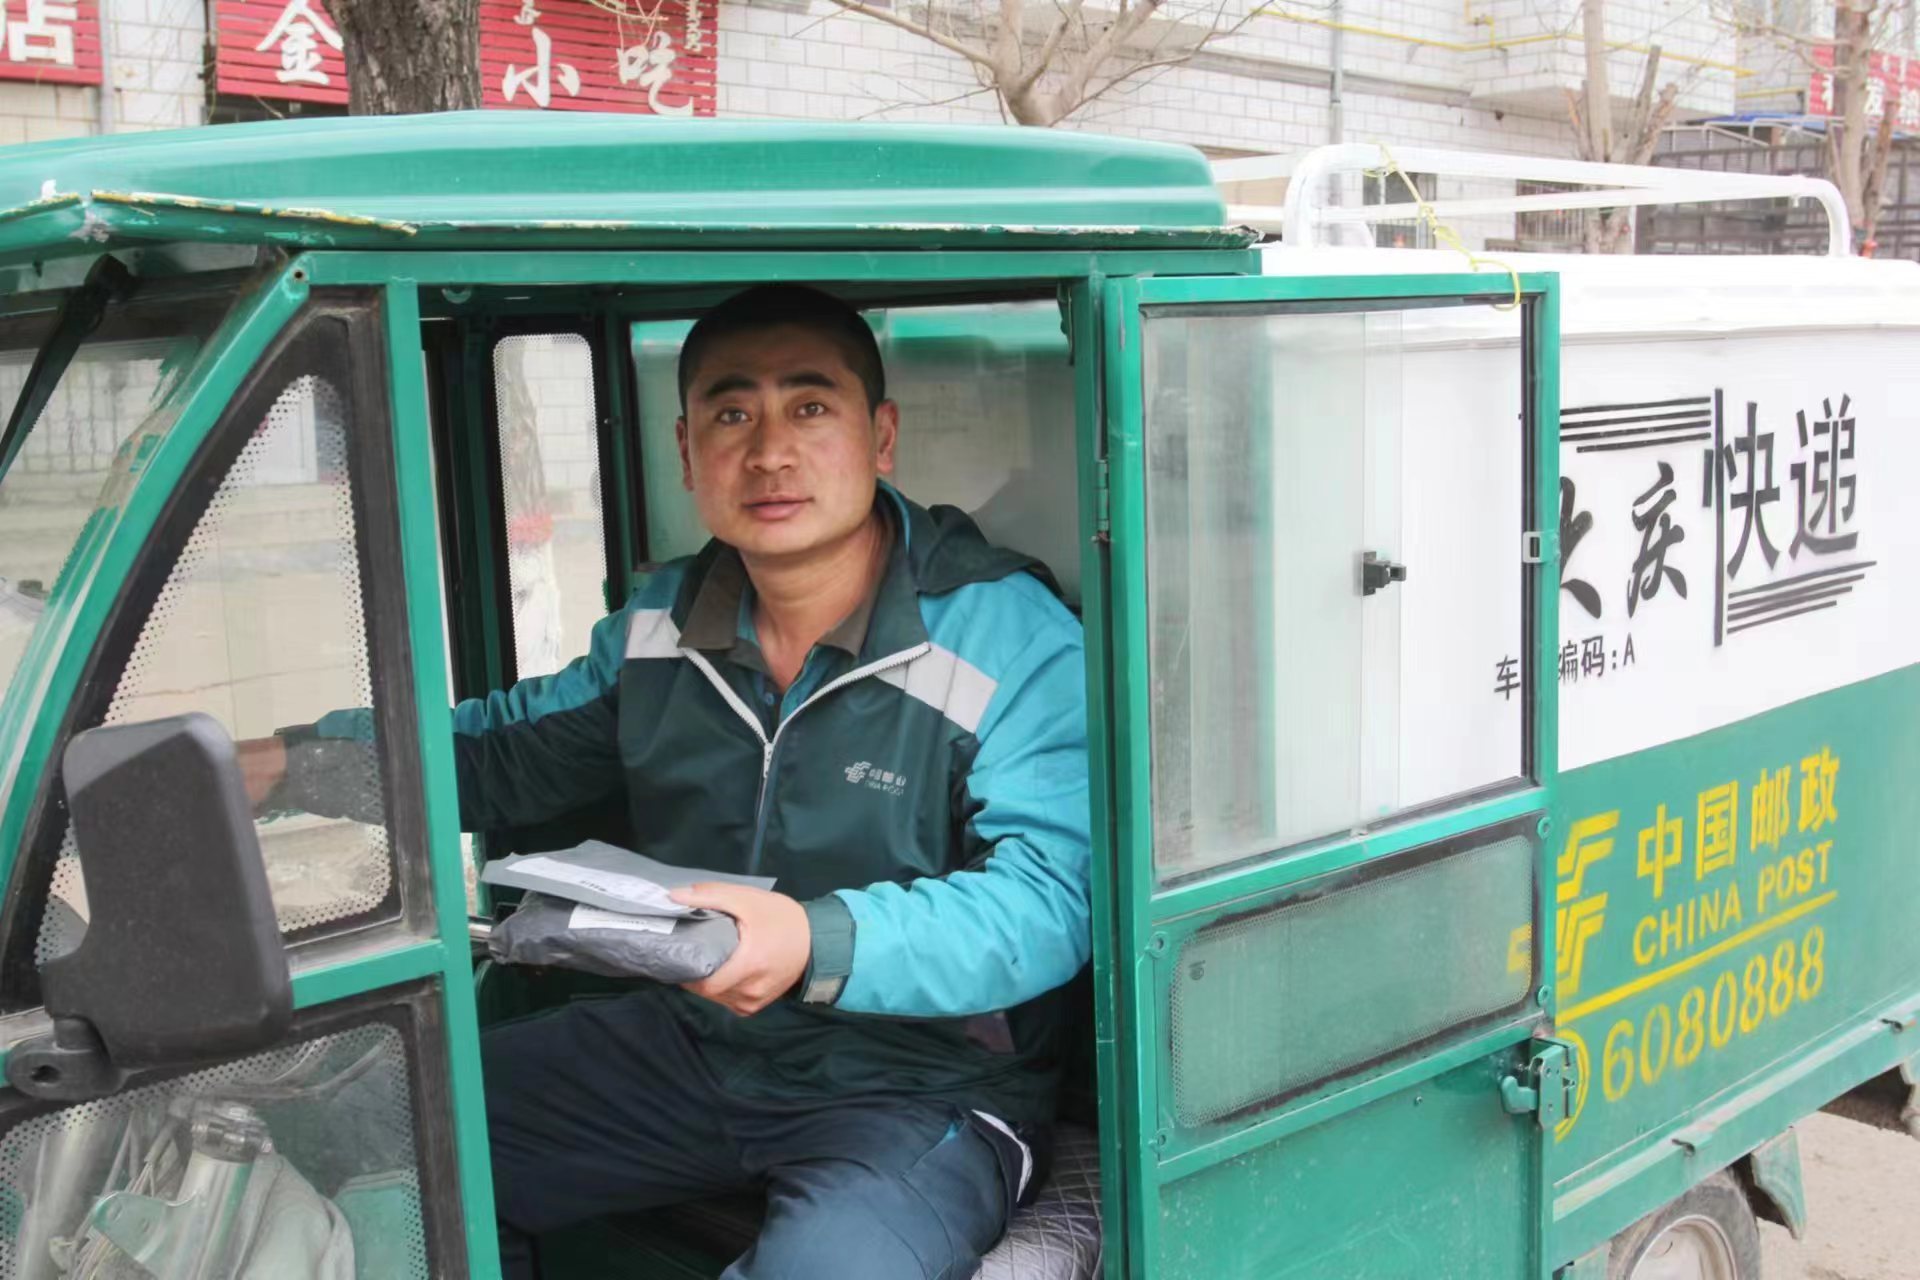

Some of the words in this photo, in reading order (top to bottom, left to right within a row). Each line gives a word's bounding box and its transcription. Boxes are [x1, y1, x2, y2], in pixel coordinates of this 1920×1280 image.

[255, 0, 344, 86] 金
[502, 27, 693, 116] 小吃
[1494, 632, 1635, 700] 车编码:A
[1636, 746, 1840, 899] 中国邮政
[1633, 881, 1742, 965] CHINA
[1758, 839, 1833, 914] POST
[1602, 925, 1825, 1103] 6080888
